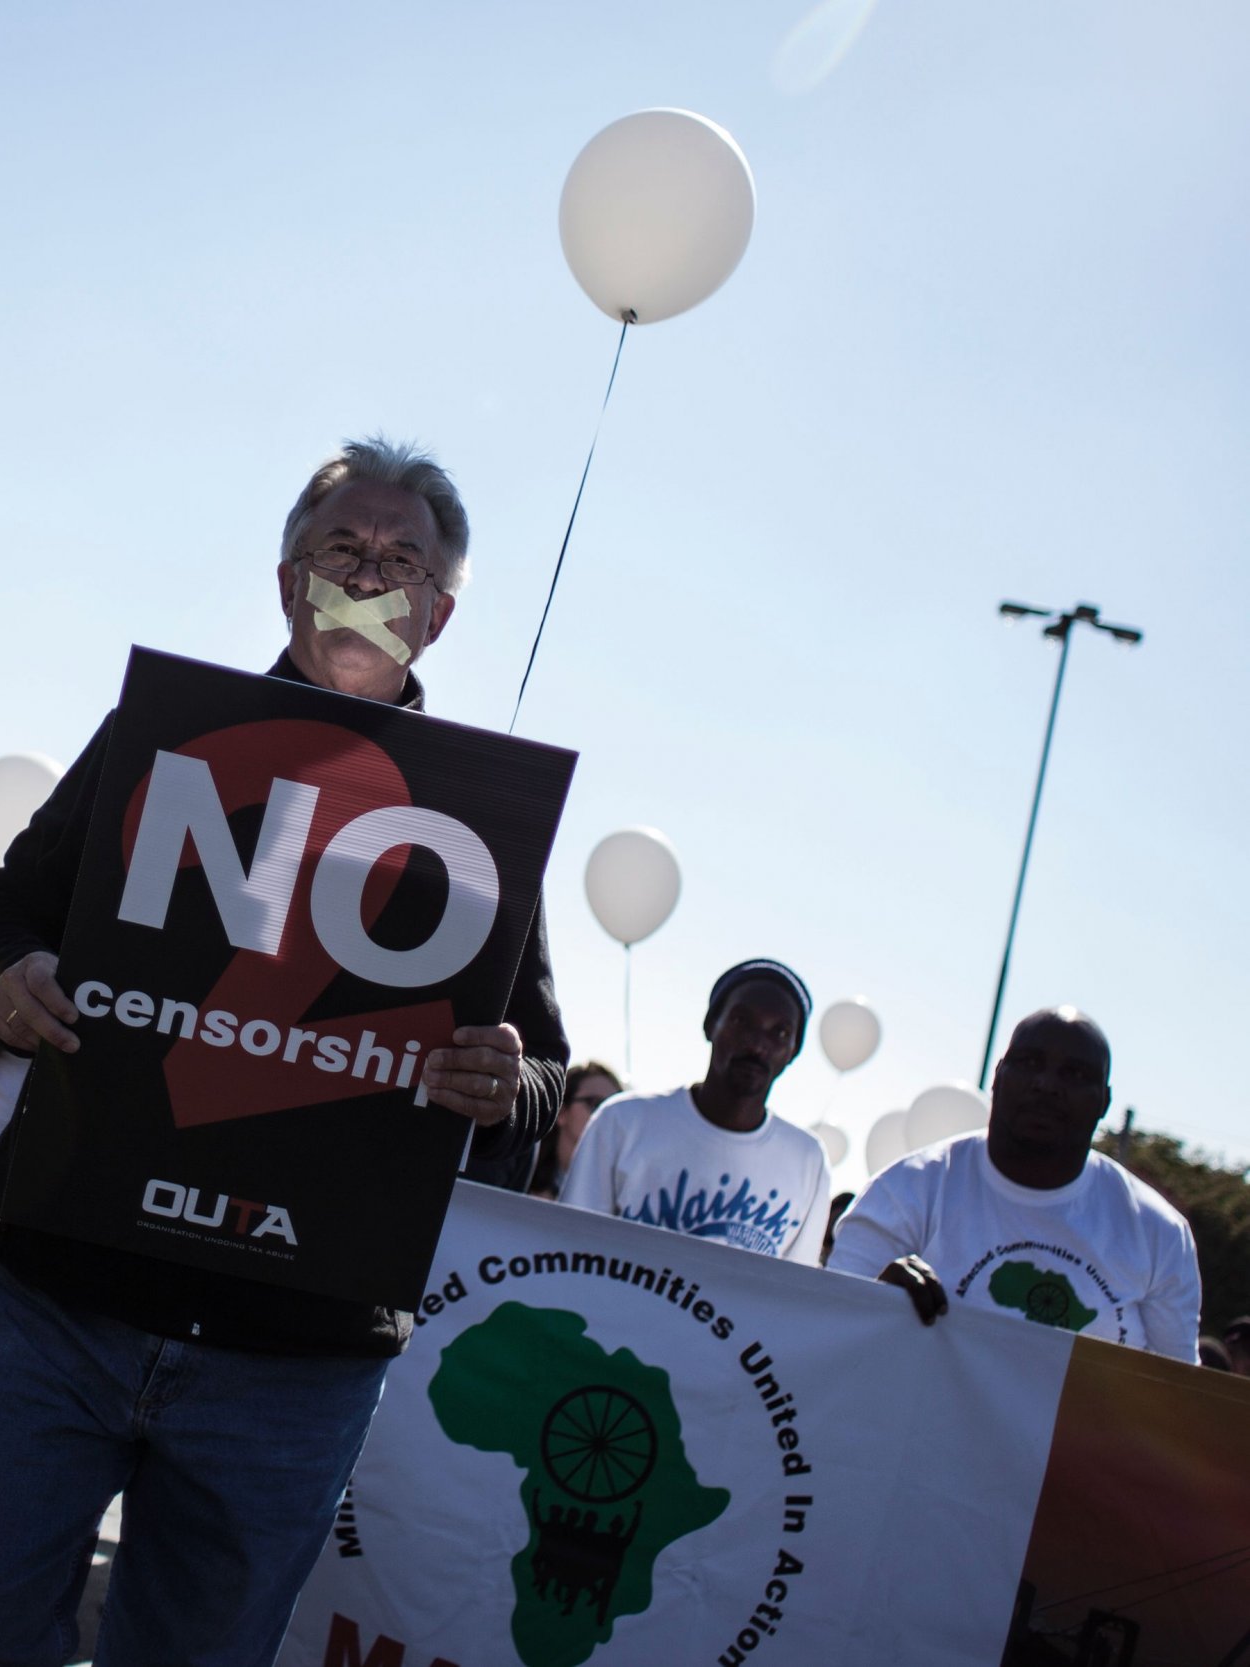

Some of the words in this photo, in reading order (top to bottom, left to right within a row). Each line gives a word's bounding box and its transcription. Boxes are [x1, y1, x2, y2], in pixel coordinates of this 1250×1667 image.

[117, 749, 500, 988] NO
[141, 1178, 299, 1247] OUTA
[478, 1250, 735, 1341] Communities
[1085, 1264, 1120, 1304] United
[738, 1341, 812, 1478] United
[782, 1495, 813, 1535] In
[717, 1548, 805, 1667] Action
